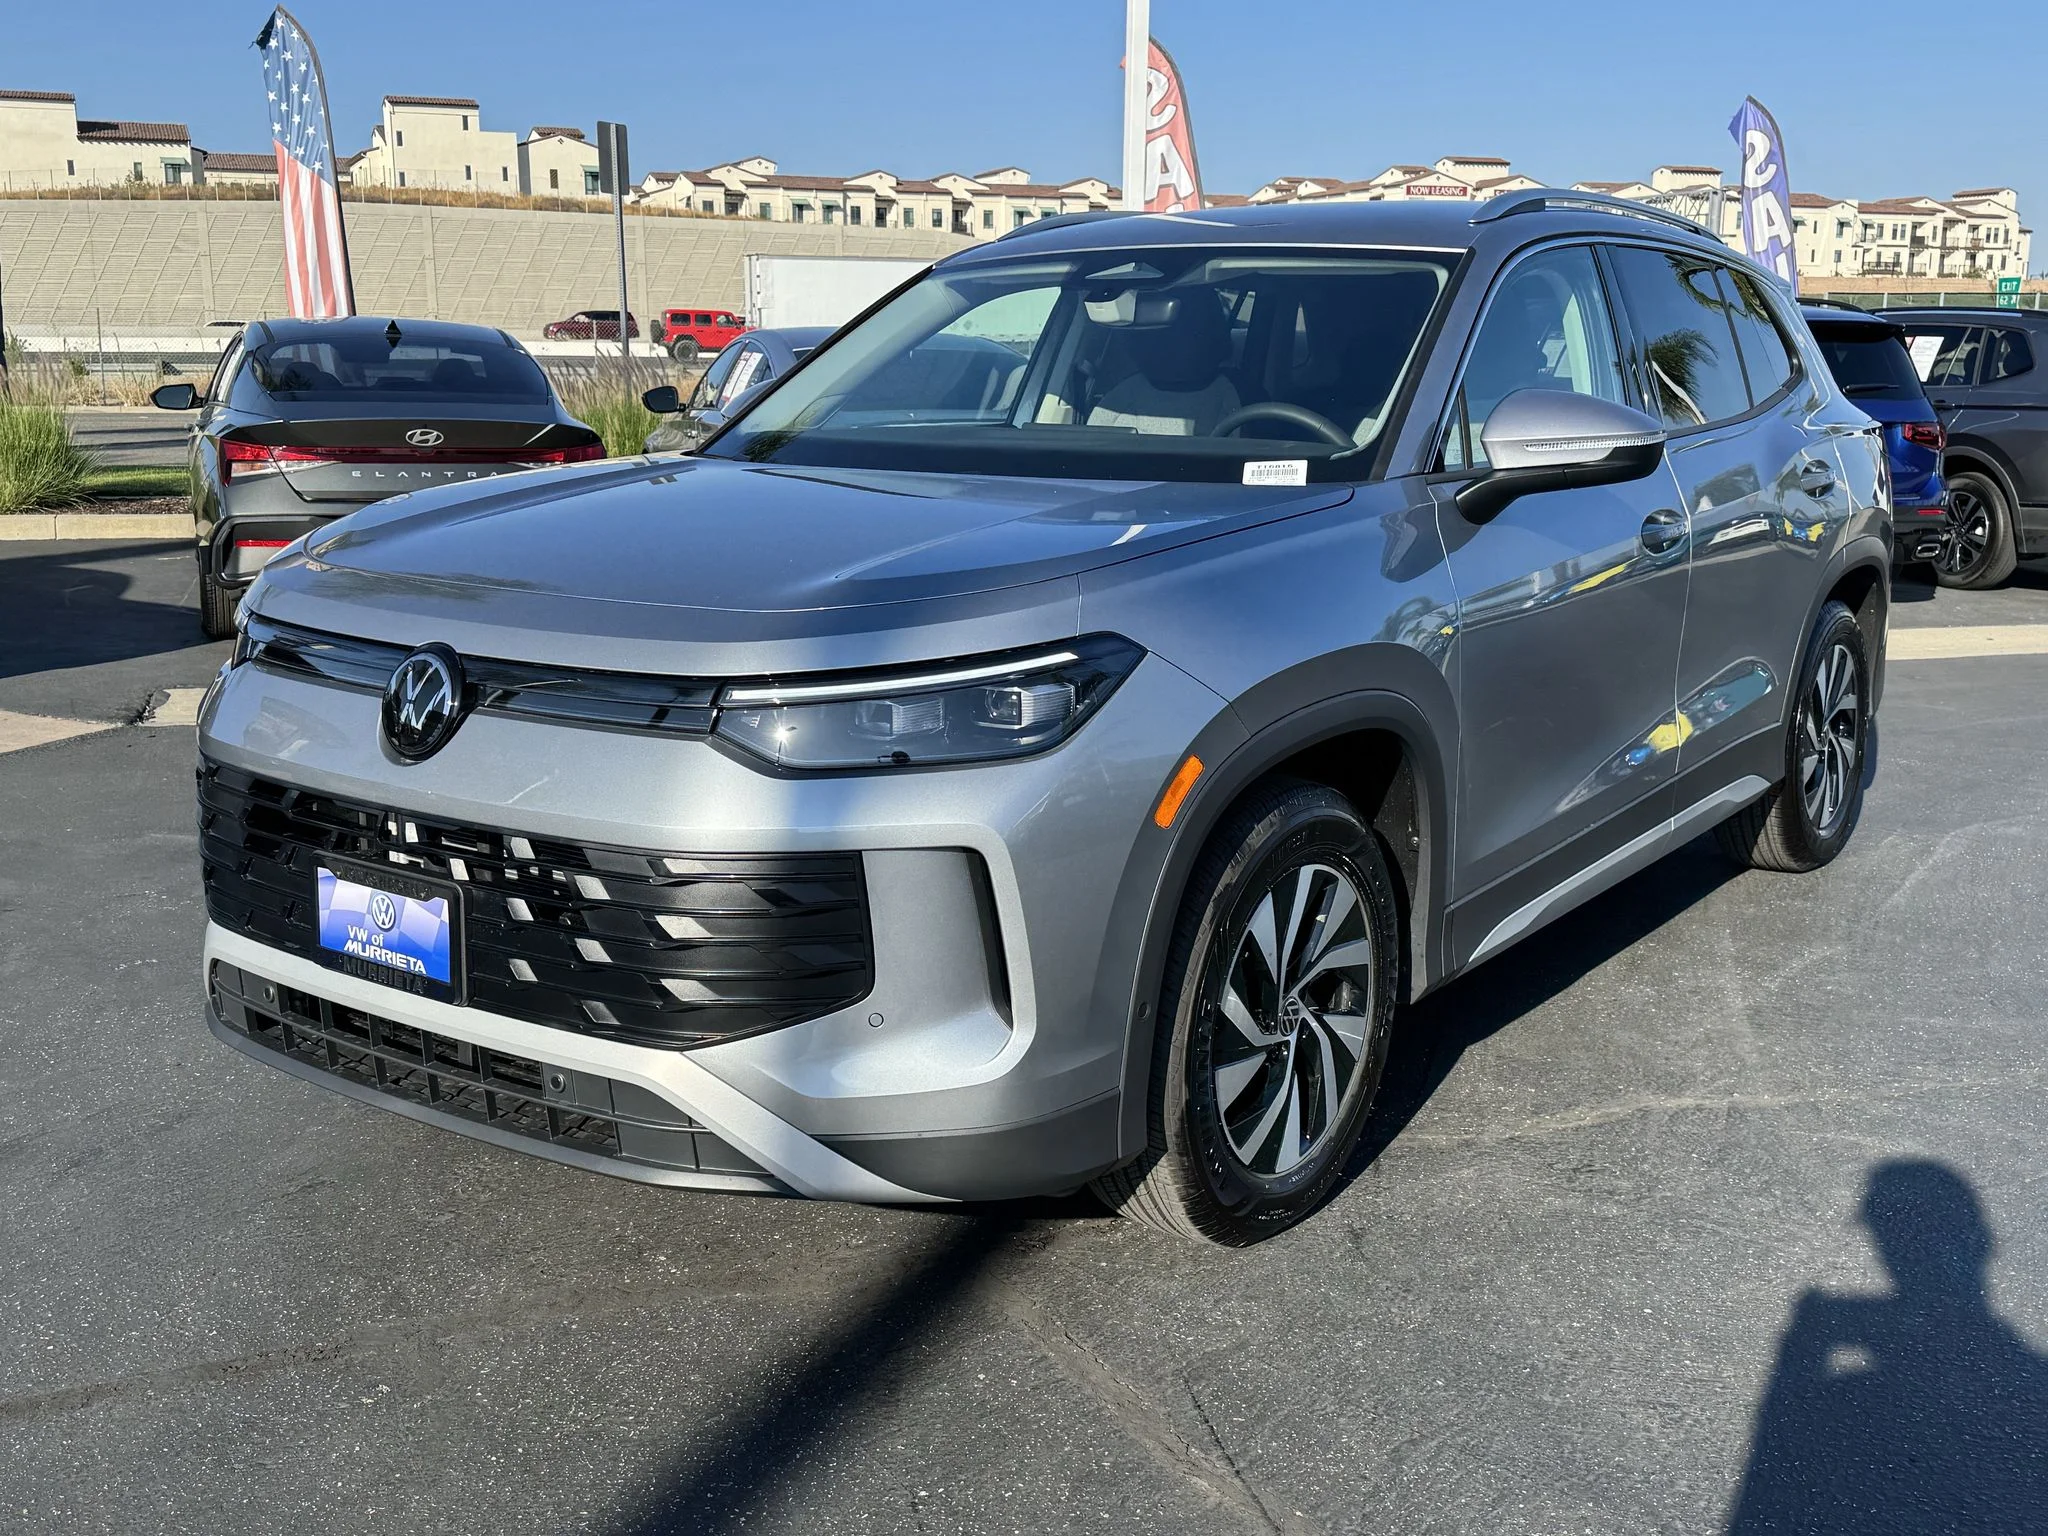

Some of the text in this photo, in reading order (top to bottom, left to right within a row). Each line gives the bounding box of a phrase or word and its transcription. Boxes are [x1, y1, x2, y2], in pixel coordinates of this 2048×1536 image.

[1410, 186, 1464, 196] NOW LEASING
[2001, 281, 2018, 291] EXIT
[352, 470, 499, 478] ELANTRA
[347, 924, 384, 947] VW of
[343, 939, 427, 975] MURRIETA
